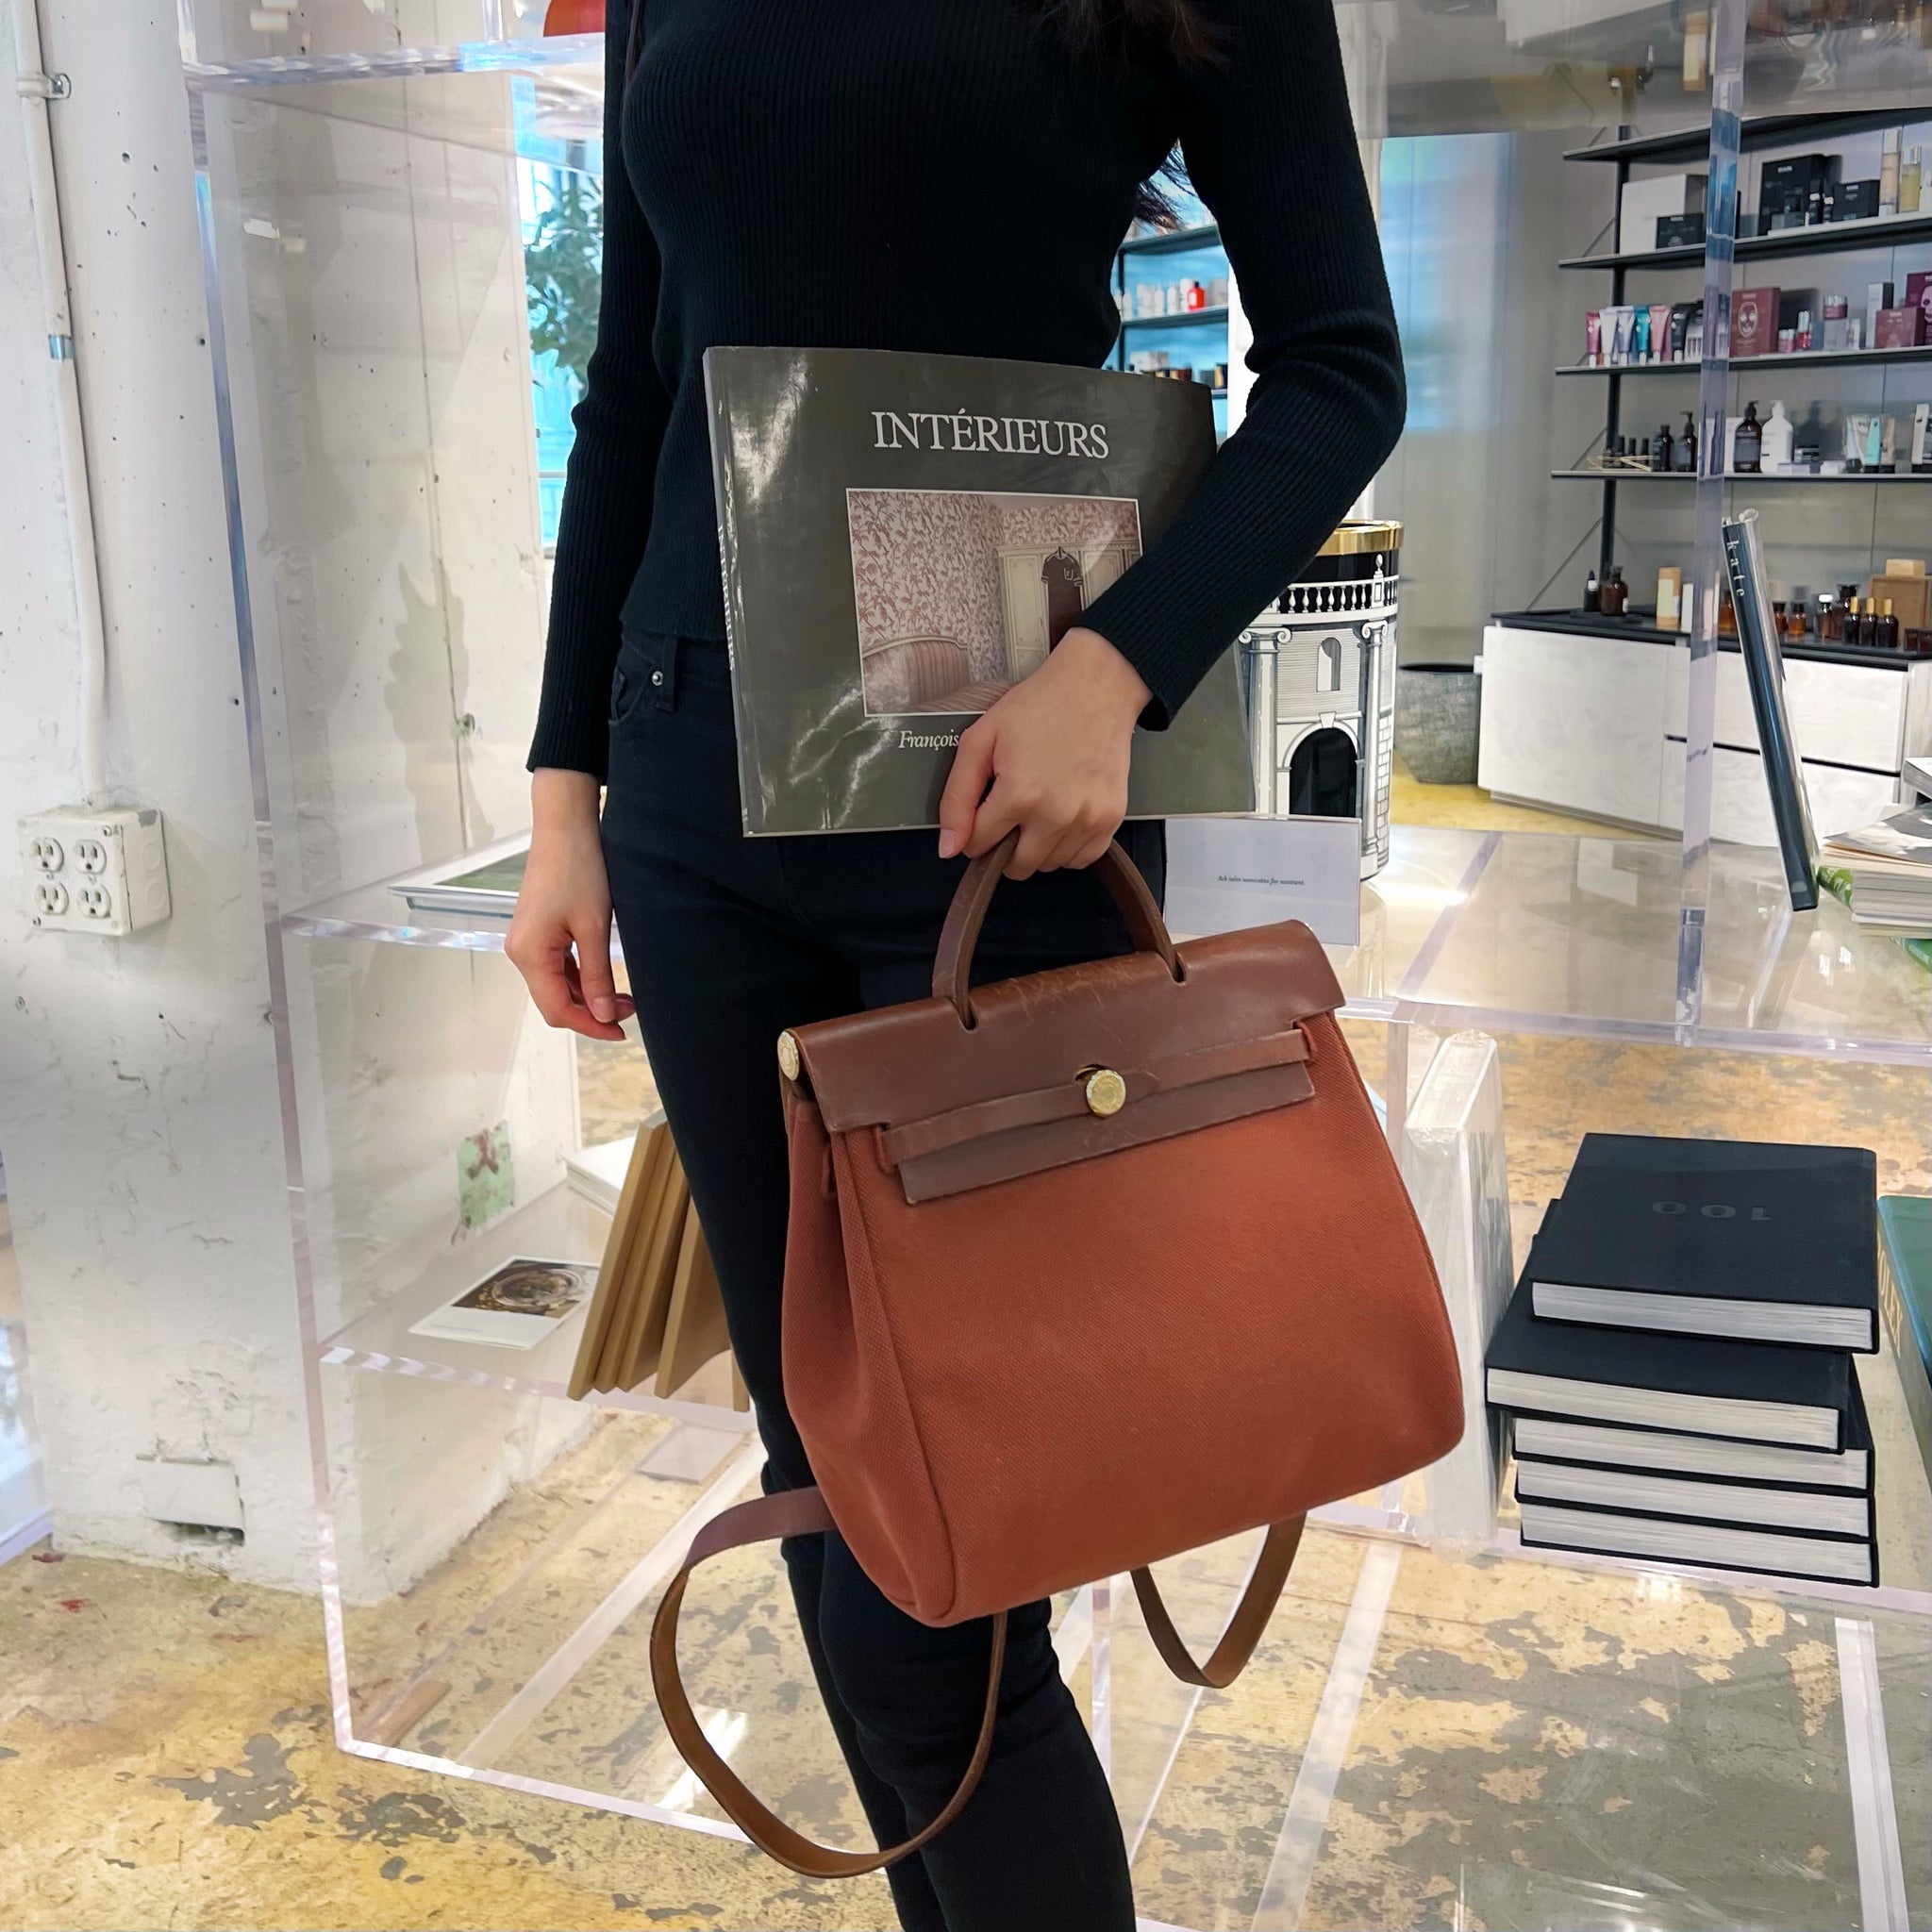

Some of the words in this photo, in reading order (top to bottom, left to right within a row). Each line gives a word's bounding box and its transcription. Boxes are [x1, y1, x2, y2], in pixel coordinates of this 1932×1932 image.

[871, 408, 1109, 458] INTÉRIEURS
[1726, 540, 1745, 596] kate
[898, 728, 959, 751] François
